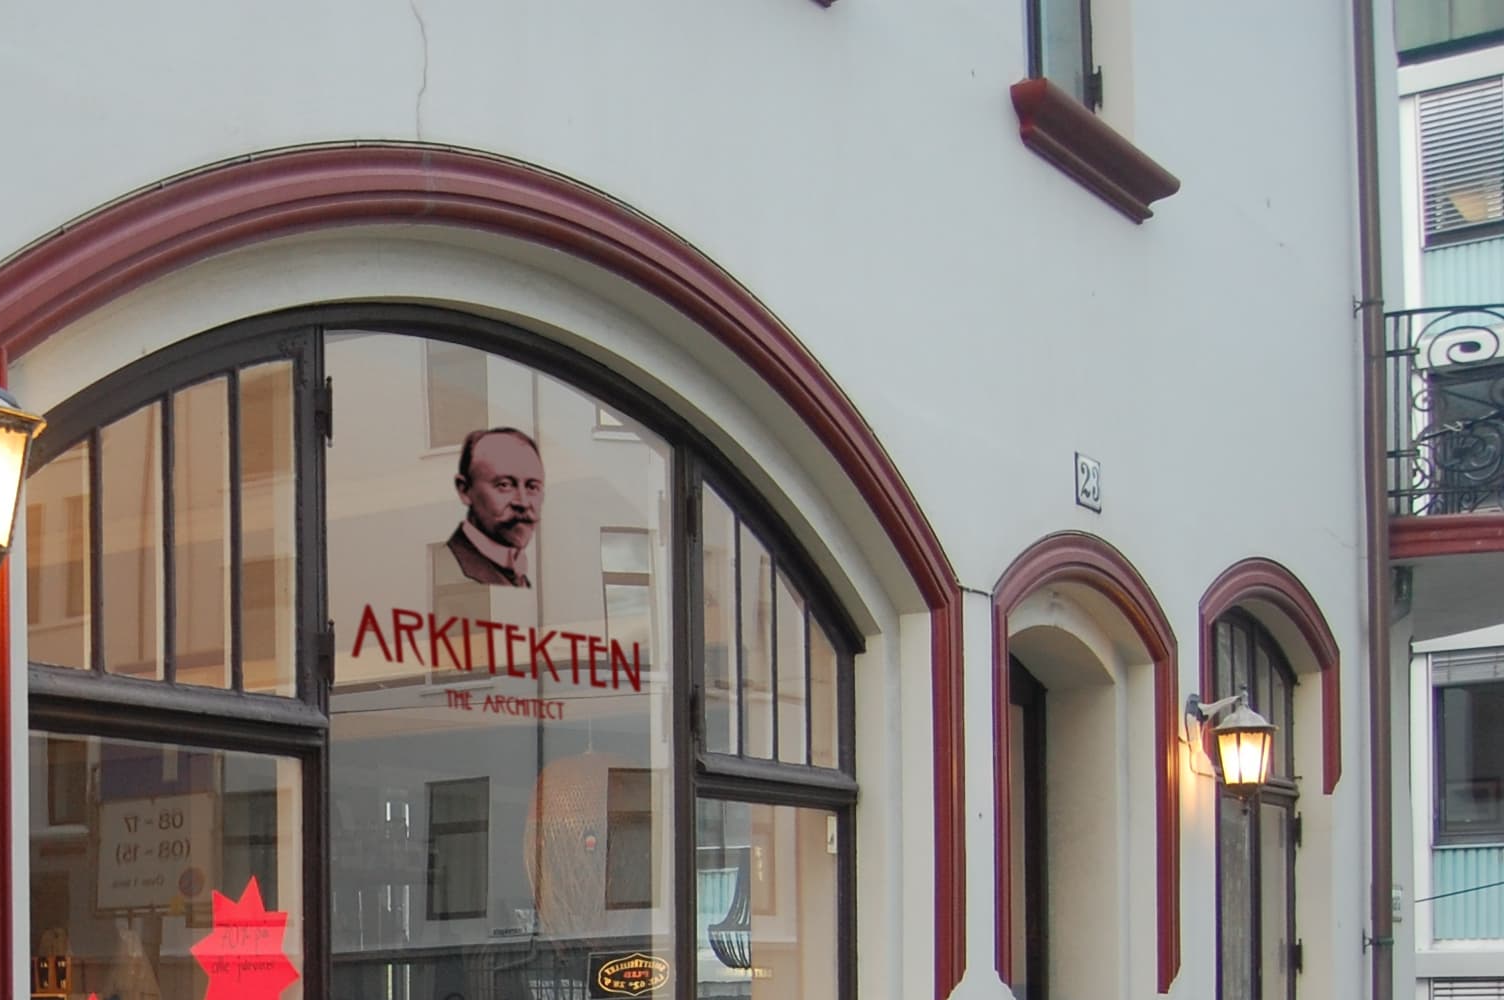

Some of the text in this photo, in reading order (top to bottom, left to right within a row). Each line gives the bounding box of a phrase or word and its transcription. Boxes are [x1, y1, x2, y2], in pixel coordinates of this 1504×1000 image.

[351, 604, 642, 692] ARKITEKTEN
[446, 689, 565, 721] THE ARCHITECT
